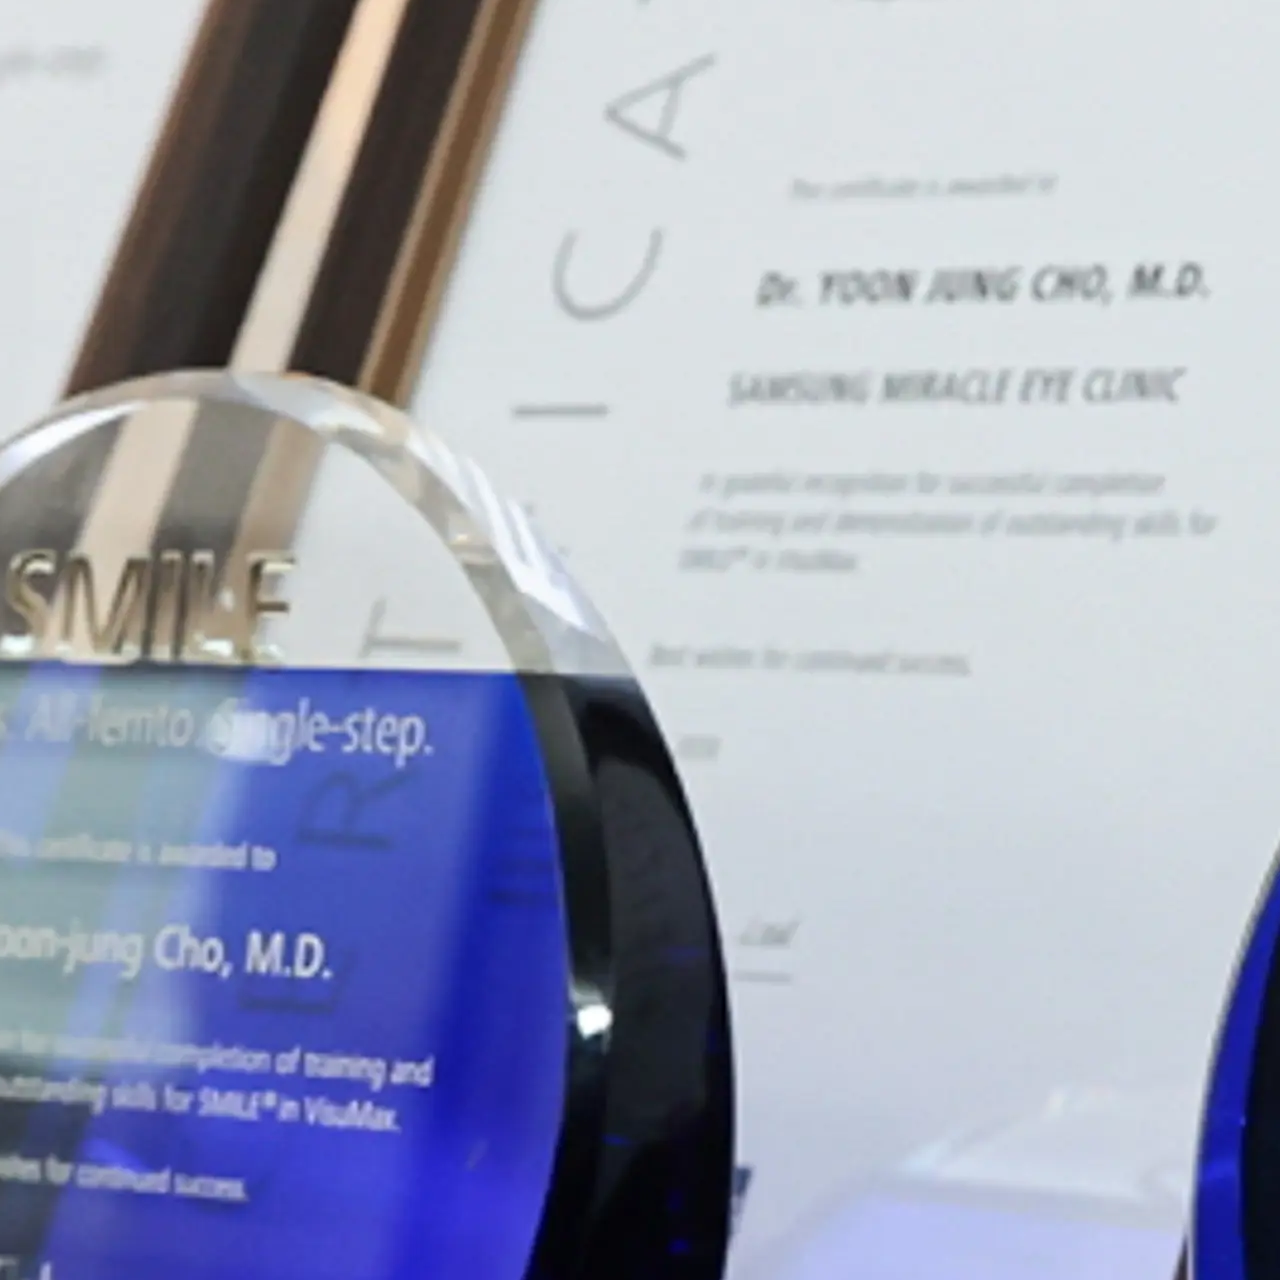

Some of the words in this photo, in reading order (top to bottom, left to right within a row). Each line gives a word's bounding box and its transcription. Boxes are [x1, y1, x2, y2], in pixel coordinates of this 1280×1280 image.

[817, 267, 918, 305] YOON
[922, 265, 1024, 305] JUNG
[1126, 261, 1211, 302] M.D.
[154, 924, 234, 981] Cho,
[245, 929, 334, 979] M.D.
